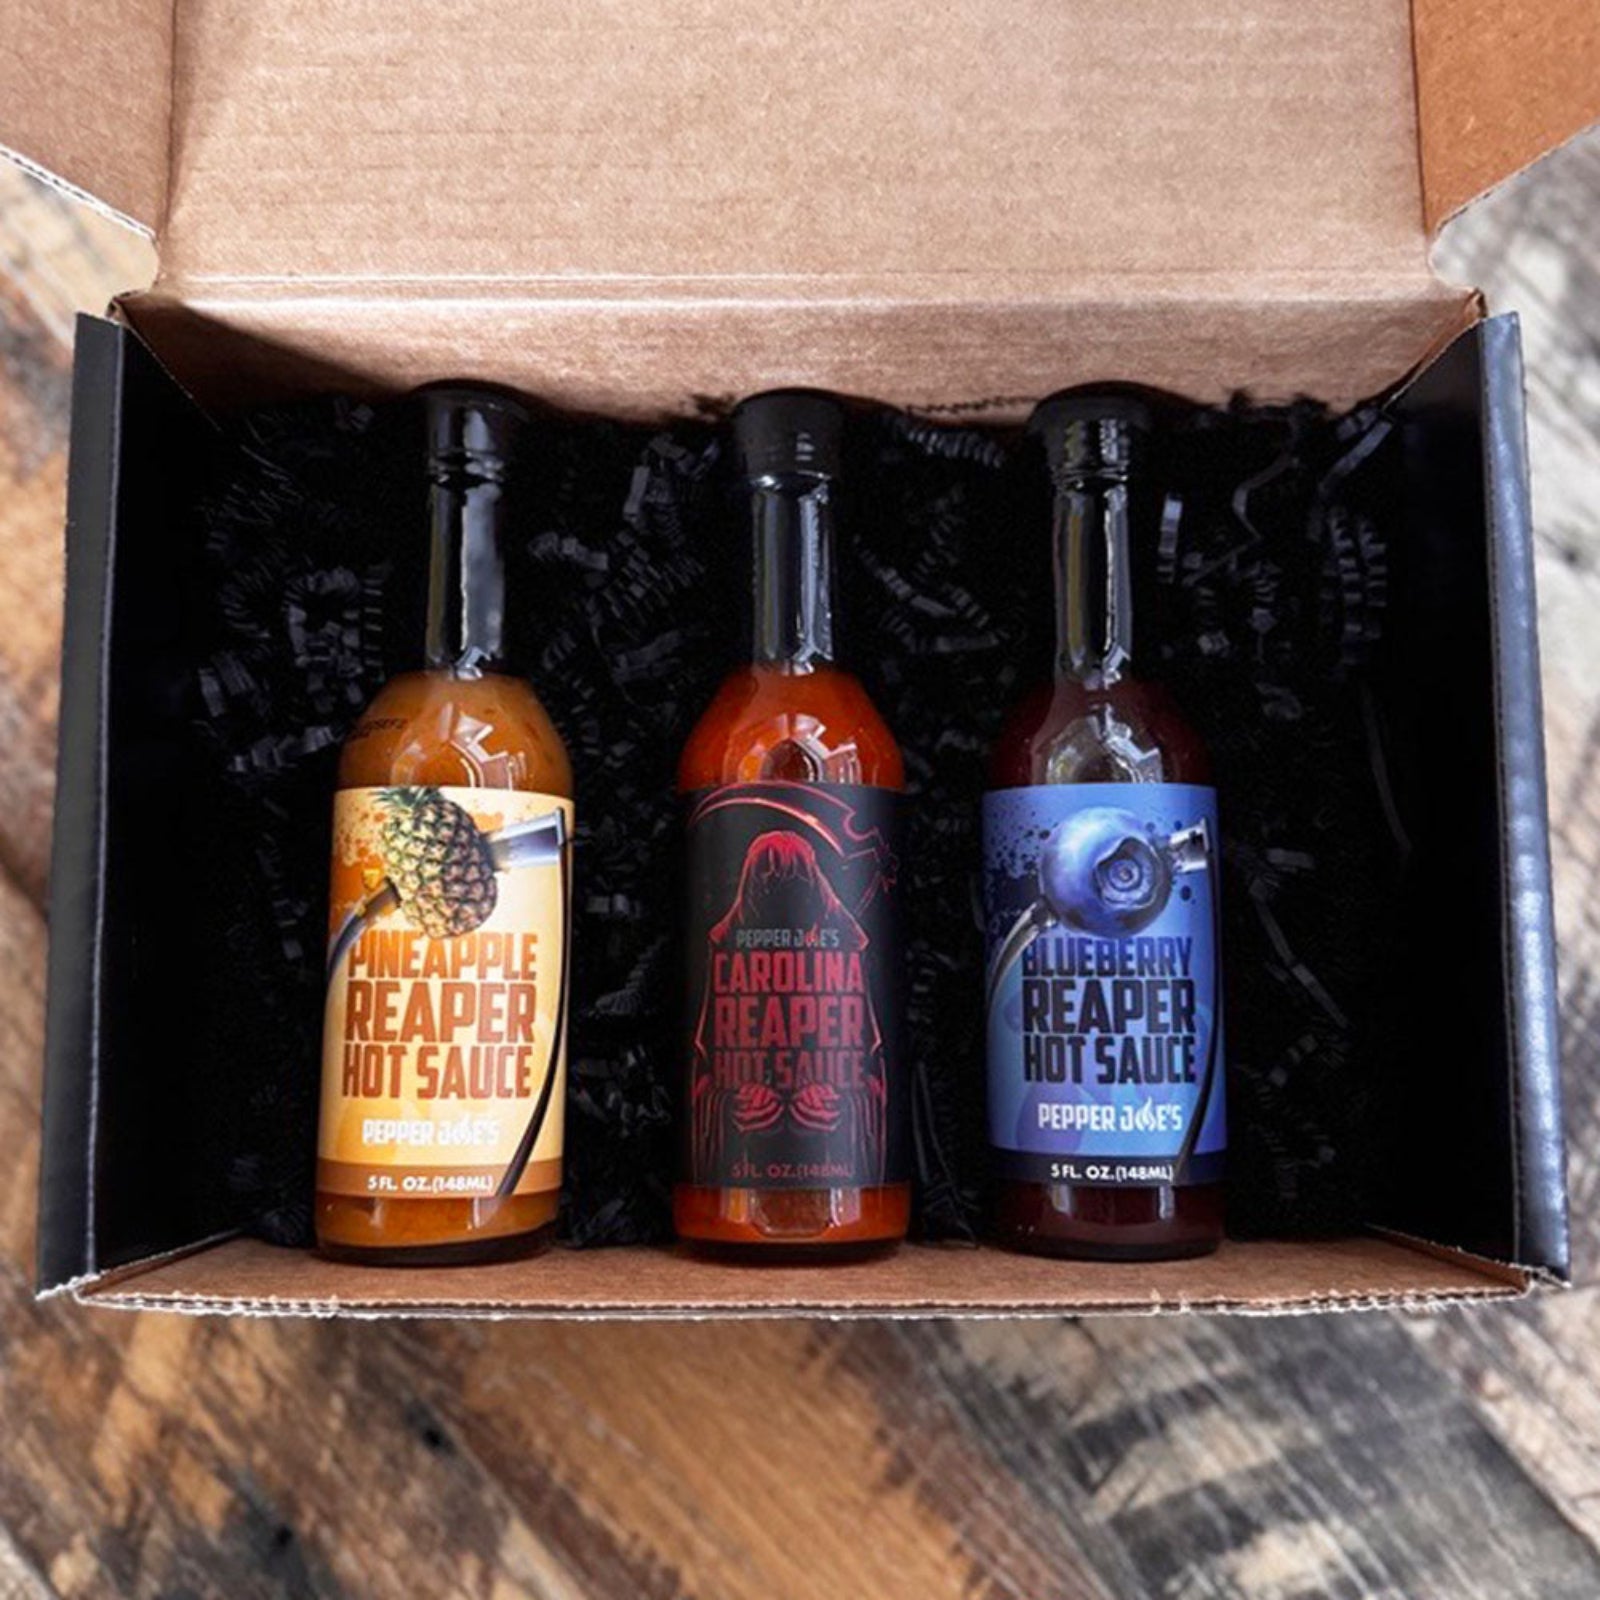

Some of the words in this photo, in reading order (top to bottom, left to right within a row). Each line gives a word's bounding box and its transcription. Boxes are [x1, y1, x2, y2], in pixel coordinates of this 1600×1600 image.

[348, 930, 537, 981] PINEAPPLE
[736, 928, 796, 948] PEPPER
[1021, 936, 1193, 977] BLUEBERRY
[714, 951, 865, 993] CAROLINA
[345, 980, 537, 1043] REAPER
[715, 996, 865, 1047] REAPER
[1022, 979, 1196, 1034] REAPER
[342, 1043, 407, 1098] HOT
[416, 1045, 533, 1099] SAUCE
[714, 1050, 768, 1088] HOT
[773, 1050, 865, 1088] SAUCE
[1023, 1034, 1086, 1083] HOT
[1095, 1035, 1196, 1084] SAUCE
[362, 1118, 433, 1145] PEPPER
[1037, 1102, 1116, 1131] PEPPER
[367, 1175, 378, 1191] 5
[379, 1175, 398, 1191] FL.
[1050, 1163, 1061, 1179] 5
[1062, 1164, 1082, 1180] FL.
